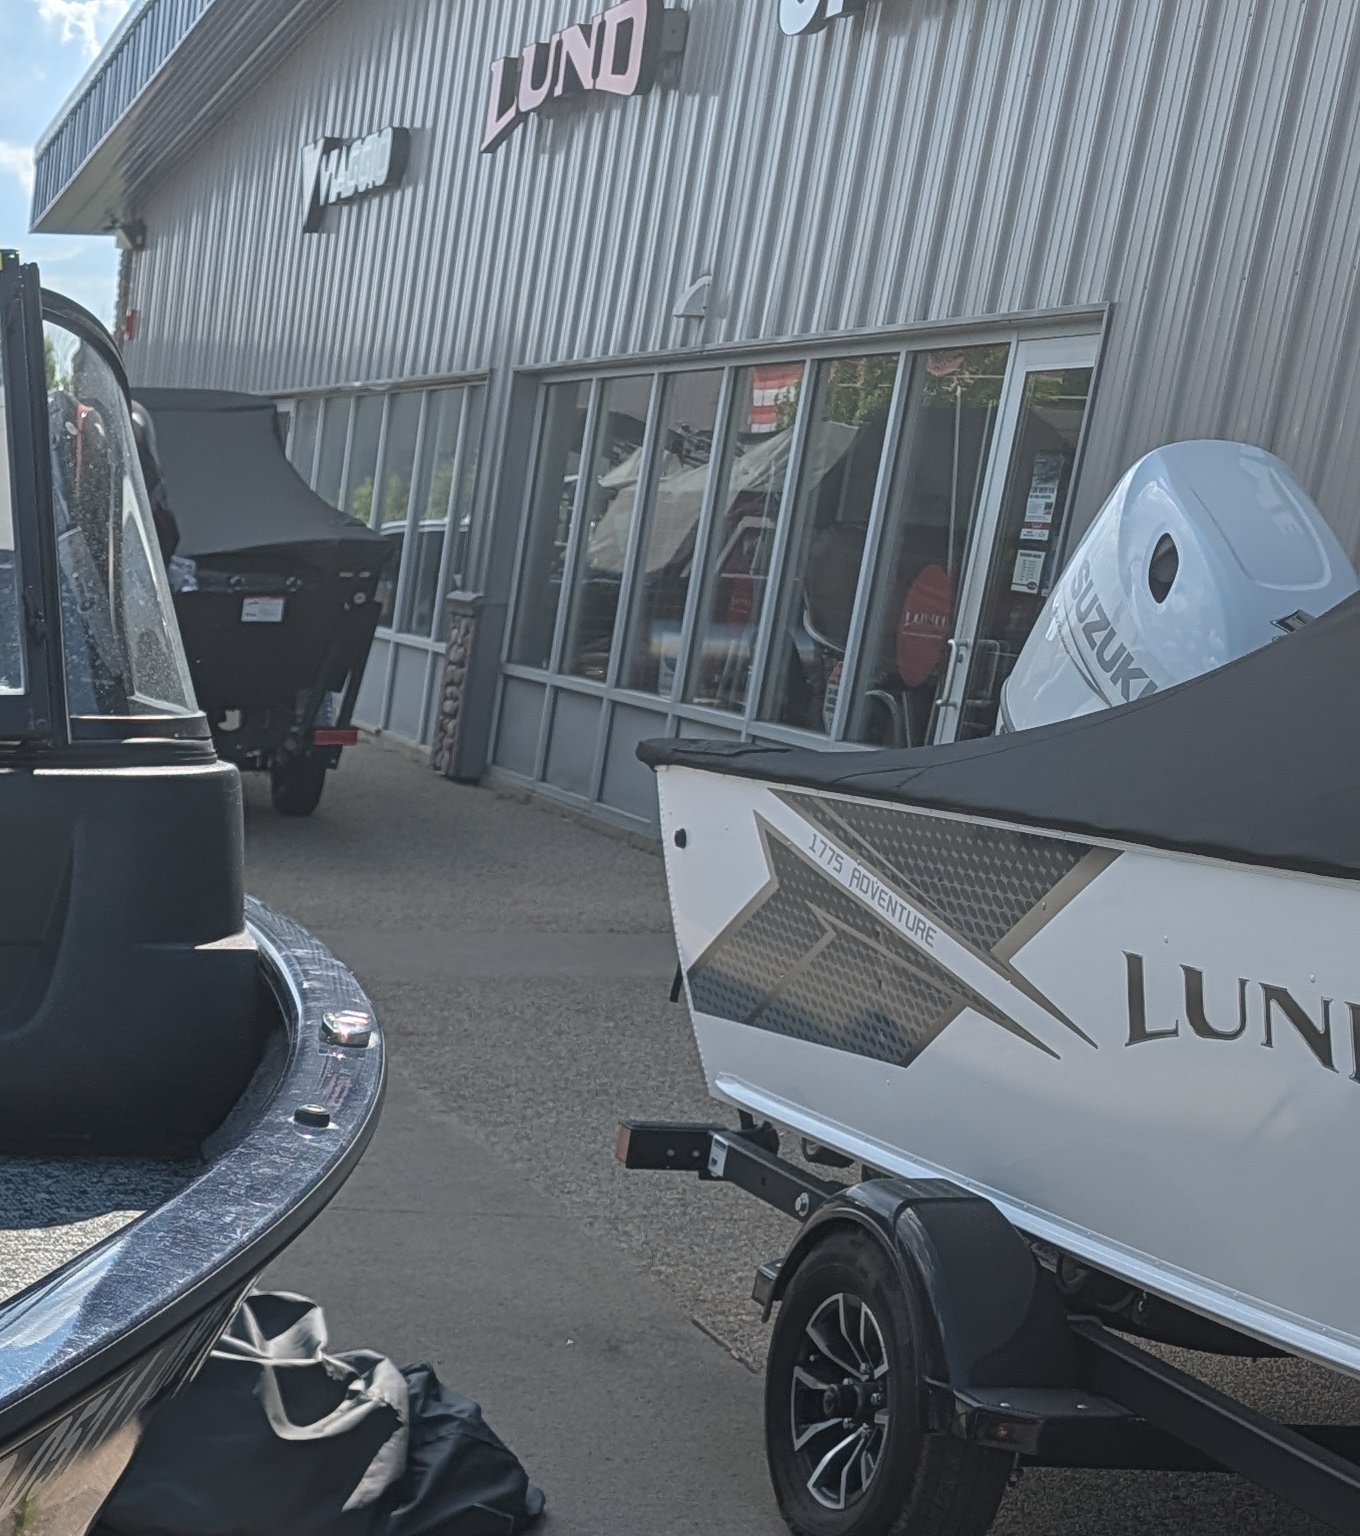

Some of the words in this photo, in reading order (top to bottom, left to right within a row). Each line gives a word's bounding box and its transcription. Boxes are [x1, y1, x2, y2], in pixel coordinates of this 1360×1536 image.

[480, 0, 648, 153] LUND
[809, 833, 844, 874] 1775
[848, 866, 938, 949] ADVENTURE
[1121, 949, 1360, 1085] LUN
